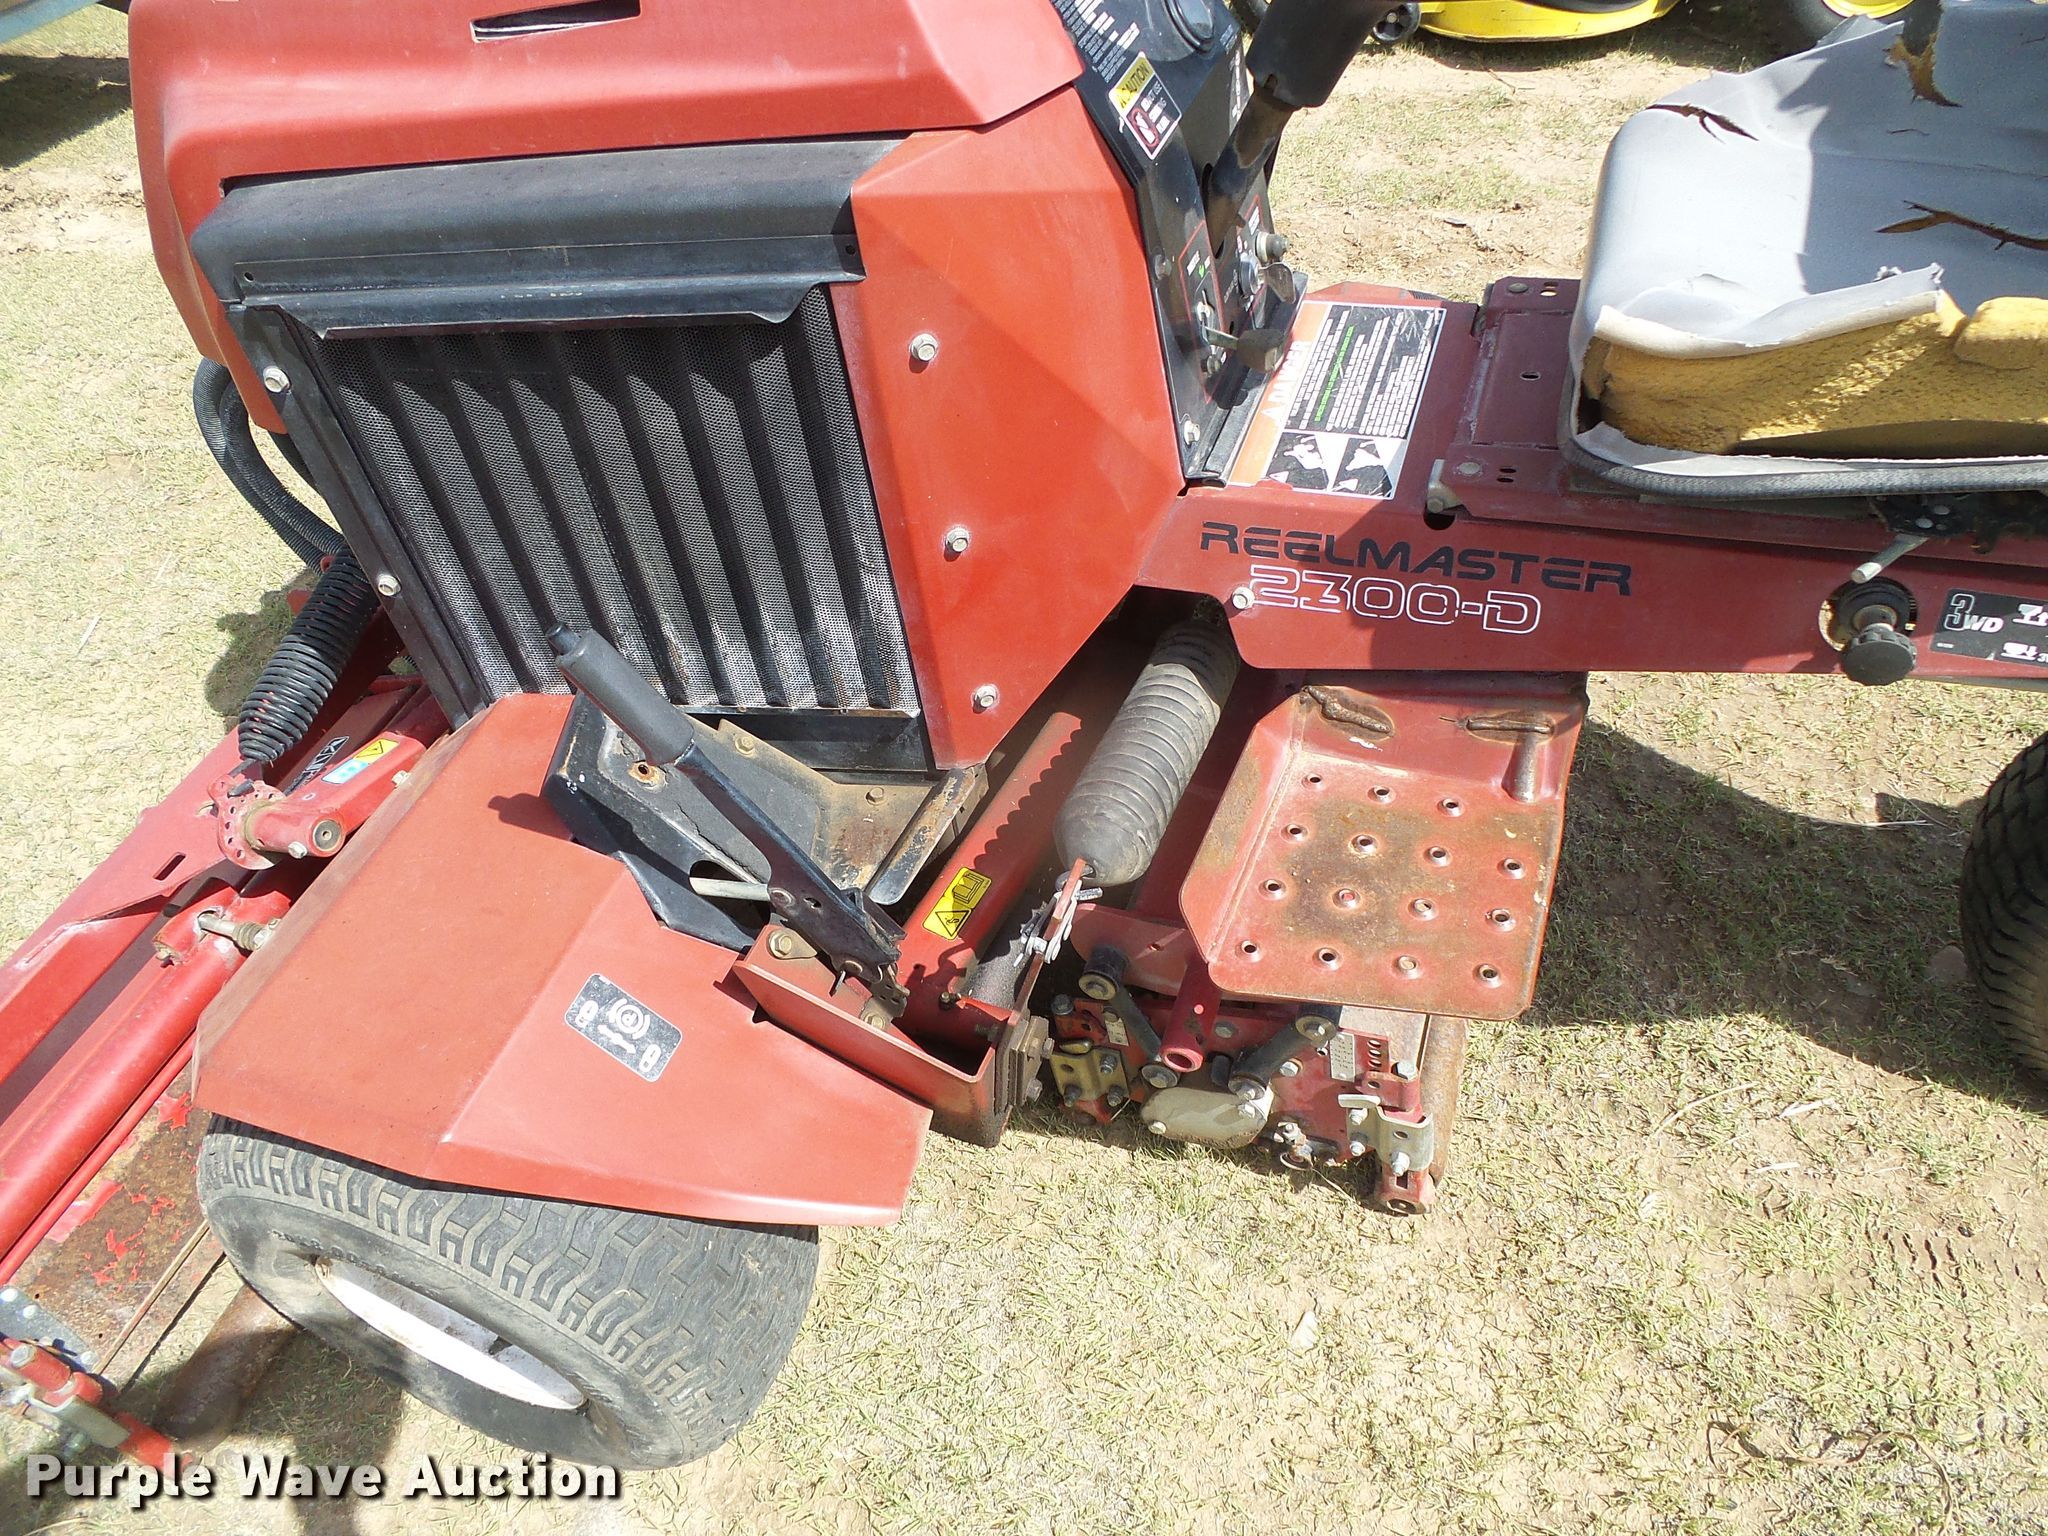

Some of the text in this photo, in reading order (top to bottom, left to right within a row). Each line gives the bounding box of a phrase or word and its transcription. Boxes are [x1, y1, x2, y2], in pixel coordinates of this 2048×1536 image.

[1121, 61, 1150, 100] CAUTION
[1201, 521, 1632, 596] REELMASTER
[1249, 564, 1541, 634] 2300-D
[1944, 593, 2004, 633] 3WD
